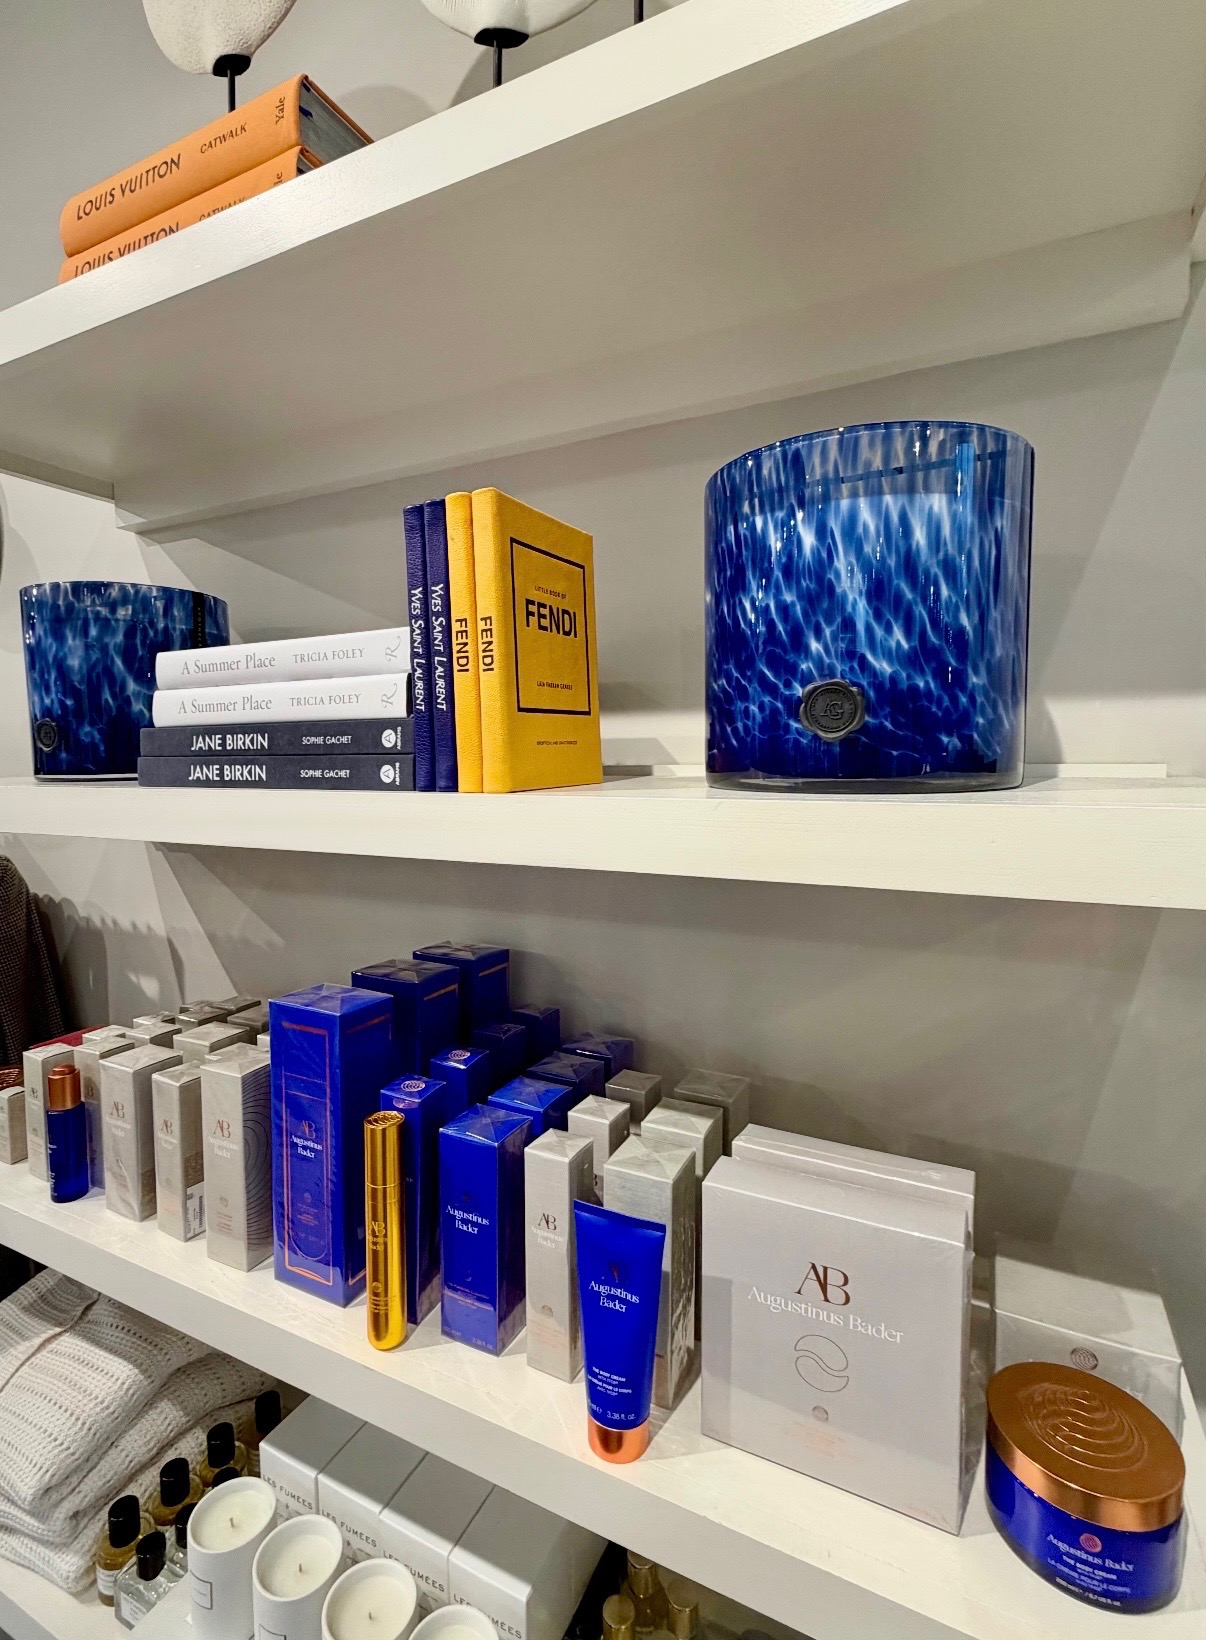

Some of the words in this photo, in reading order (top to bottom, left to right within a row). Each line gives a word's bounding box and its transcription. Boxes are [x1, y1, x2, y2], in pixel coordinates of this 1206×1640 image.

[276, 96, 286, 124] Yale
[76, 188, 116, 222] LOUIS
[120, 153, 181, 198] VUITTON
[200, 122, 247, 154] CATWALK
[525, 598, 577, 638] FENDI
[455, 618, 469, 672] FENDI
[480, 616, 494, 672] FENDI
[182, 661, 191, 675] A
[194, 658, 241, 674] Summer
[245, 653, 276, 670] Place
[293, 652, 328, 664] TRICIA
[332, 648, 365, 660] FOLEY
[178, 700, 188, 714] A
[191, 699, 238, 713] Summer
[242, 695, 272, 710] Place
[290, 696, 324, 707] TRICIA
[329, 694, 362, 705] FOLEY
[191, 735, 222, 751] JANE
[226, 734, 268, 750] BIRKIN
[302, 736, 324, 744] SOPHIE
[326, 735, 352, 744] GACHET
[188, 765, 221, 781] JANE
[224, 765, 266, 781] BIRKIN
[300, 769, 323, 778] SOPHIE
[324, 769, 350, 778] GACHET
[110, 1101, 124, 1118] AB
[161, 1119, 172, 1134] AB
[214, 1119, 231, 1138] AB
[290, 1135, 322, 1150] Augustinus
[446, 1205, 489, 1225] Augustinus
[538, 1213, 556, 1230] AB
[456, 1220, 478, 1234] Bader
[589, 1280, 640, 1303] Augustinus
[794, 1262, 851, 1306] AB
[600, 1296, 626, 1312] Bader
[748, 1286, 844, 1326] Augustinus
[849, 1314, 904, 1344] Bader
[607, 1410, 620, 1420] 3.38
[383, 1550, 399, 1562] LE
[454, 1593, 472, 1606] LE
